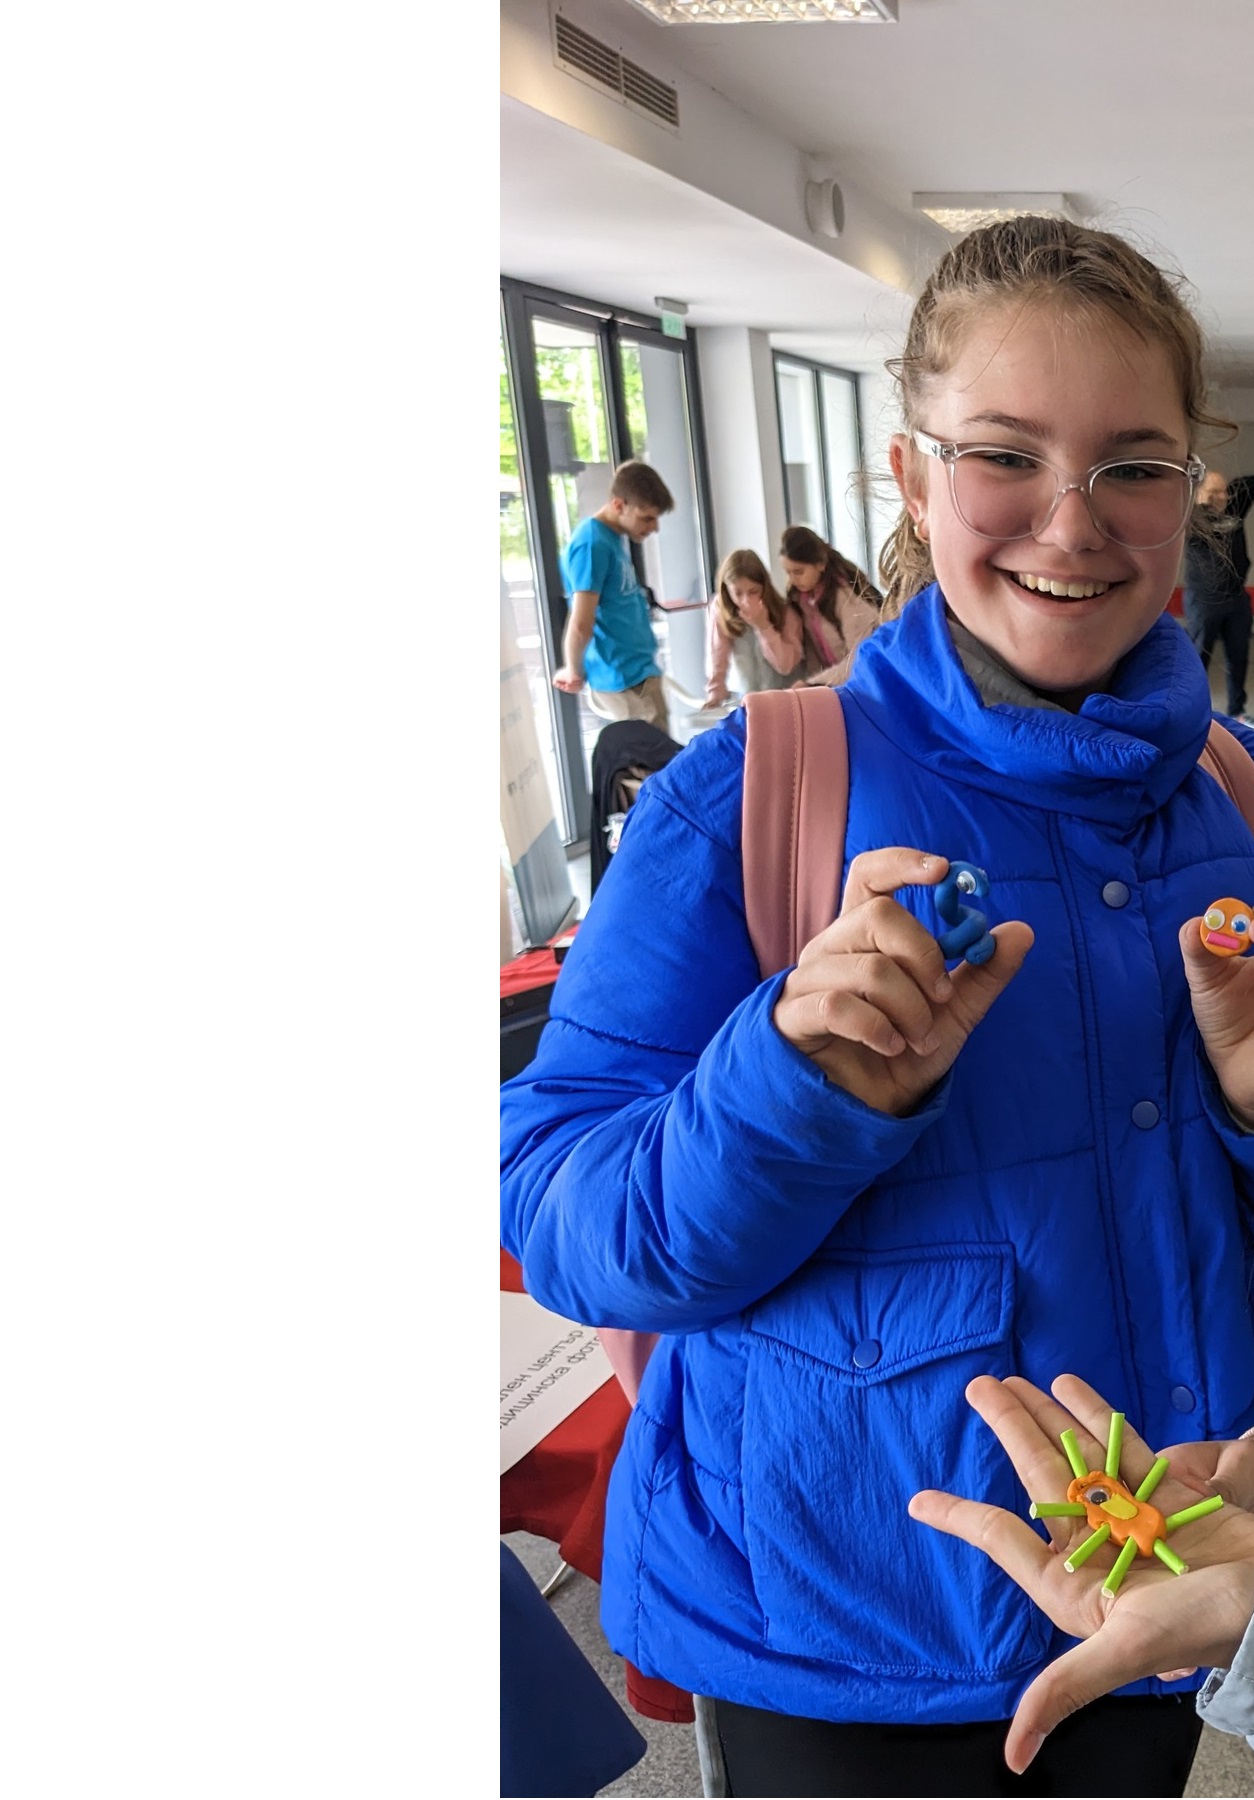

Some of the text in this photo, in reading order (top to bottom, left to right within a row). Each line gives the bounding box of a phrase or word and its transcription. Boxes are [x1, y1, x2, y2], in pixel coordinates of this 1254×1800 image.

[500, 1329, 584, 1403] лен център
[500, 1366, 571, 1430] дицинска
